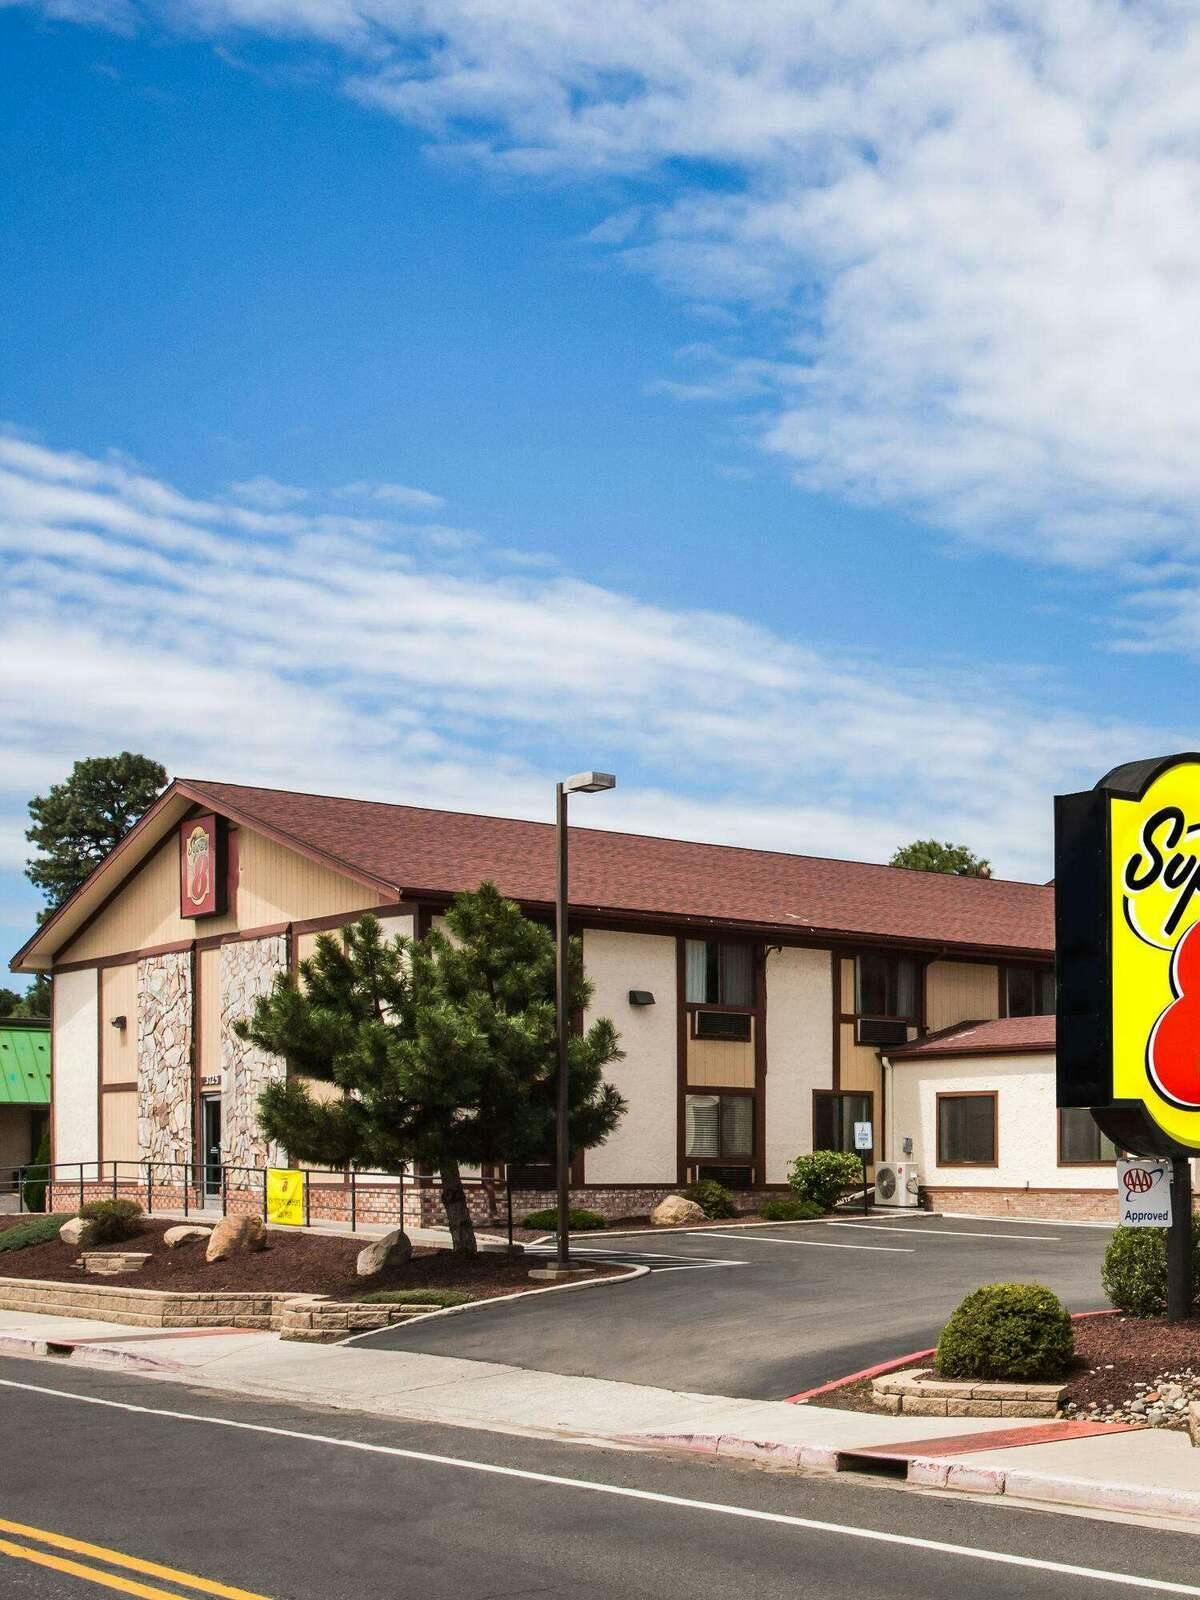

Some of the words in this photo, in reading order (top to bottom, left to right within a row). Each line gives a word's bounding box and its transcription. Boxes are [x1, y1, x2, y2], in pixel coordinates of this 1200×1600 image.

[192, 854, 208, 900] 8
[1125, 1168, 1152, 1193] AAA
[1125, 1210, 1168, 1222] Approved
